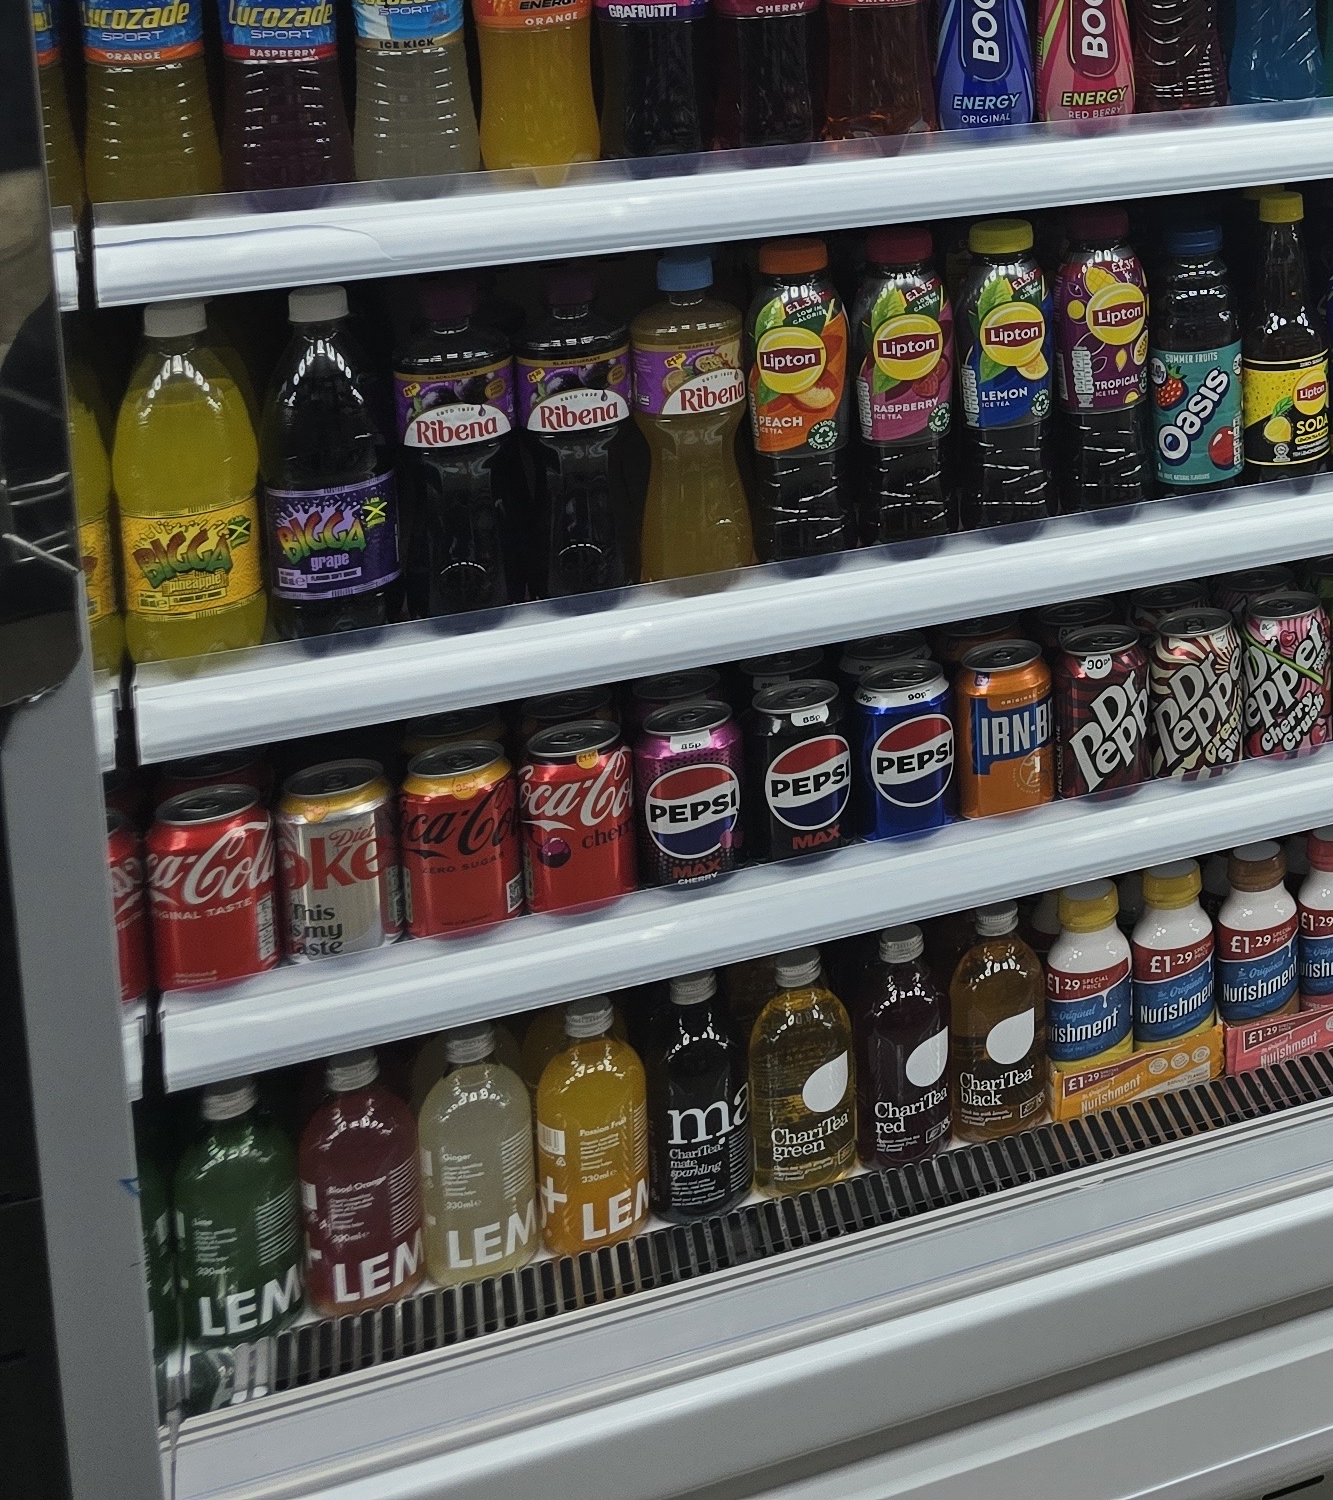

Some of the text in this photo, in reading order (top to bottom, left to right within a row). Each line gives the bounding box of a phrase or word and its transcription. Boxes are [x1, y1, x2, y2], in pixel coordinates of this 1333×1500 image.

[229, 0, 332, 26] Lucozade
[251, 29, 312, 41] SPORT
[379, 37, 434, 49] ICE KICK
[249, 46, 316, 58] RASPBERRY
[961, 112, 1010, 124] ORIGINAL
[1068, 105, 1122, 118] RED BERRY
[984, 323, 1039, 344] Lipton
[877, 335, 935, 357] Lipton
[763, 348, 816, 371] Lipton
[1165, 352, 1218, 363] SUMMER FRUITS
[1095, 376, 1139, 391] TROPICAL
[981, 387, 1028, 401] LEMON
[873, 399, 938, 414] RASPBERRY
[1157, 367, 1228, 459] Oasis
[416, 414, 497, 445] Ribena
[759, 416, 803, 428] PEACH
[277, 508, 366, 565] BIGGA
[311, 552, 350, 569] grape
[771, 762, 850, 798] PEPSI
[649, 791, 737, 824] PEPSI
[792, 826, 841, 850] MAX
[677, 871, 718, 884] CHERRY
[1150, 951, 1192, 973] £1.29
[959, 1067, 1033, 1093] ChariTea
[1068, 1074, 1099, 1093] £1.29
[960, 1089, 1001, 1106] black
[1081, 1074, 1141, 1112] Nurishment
